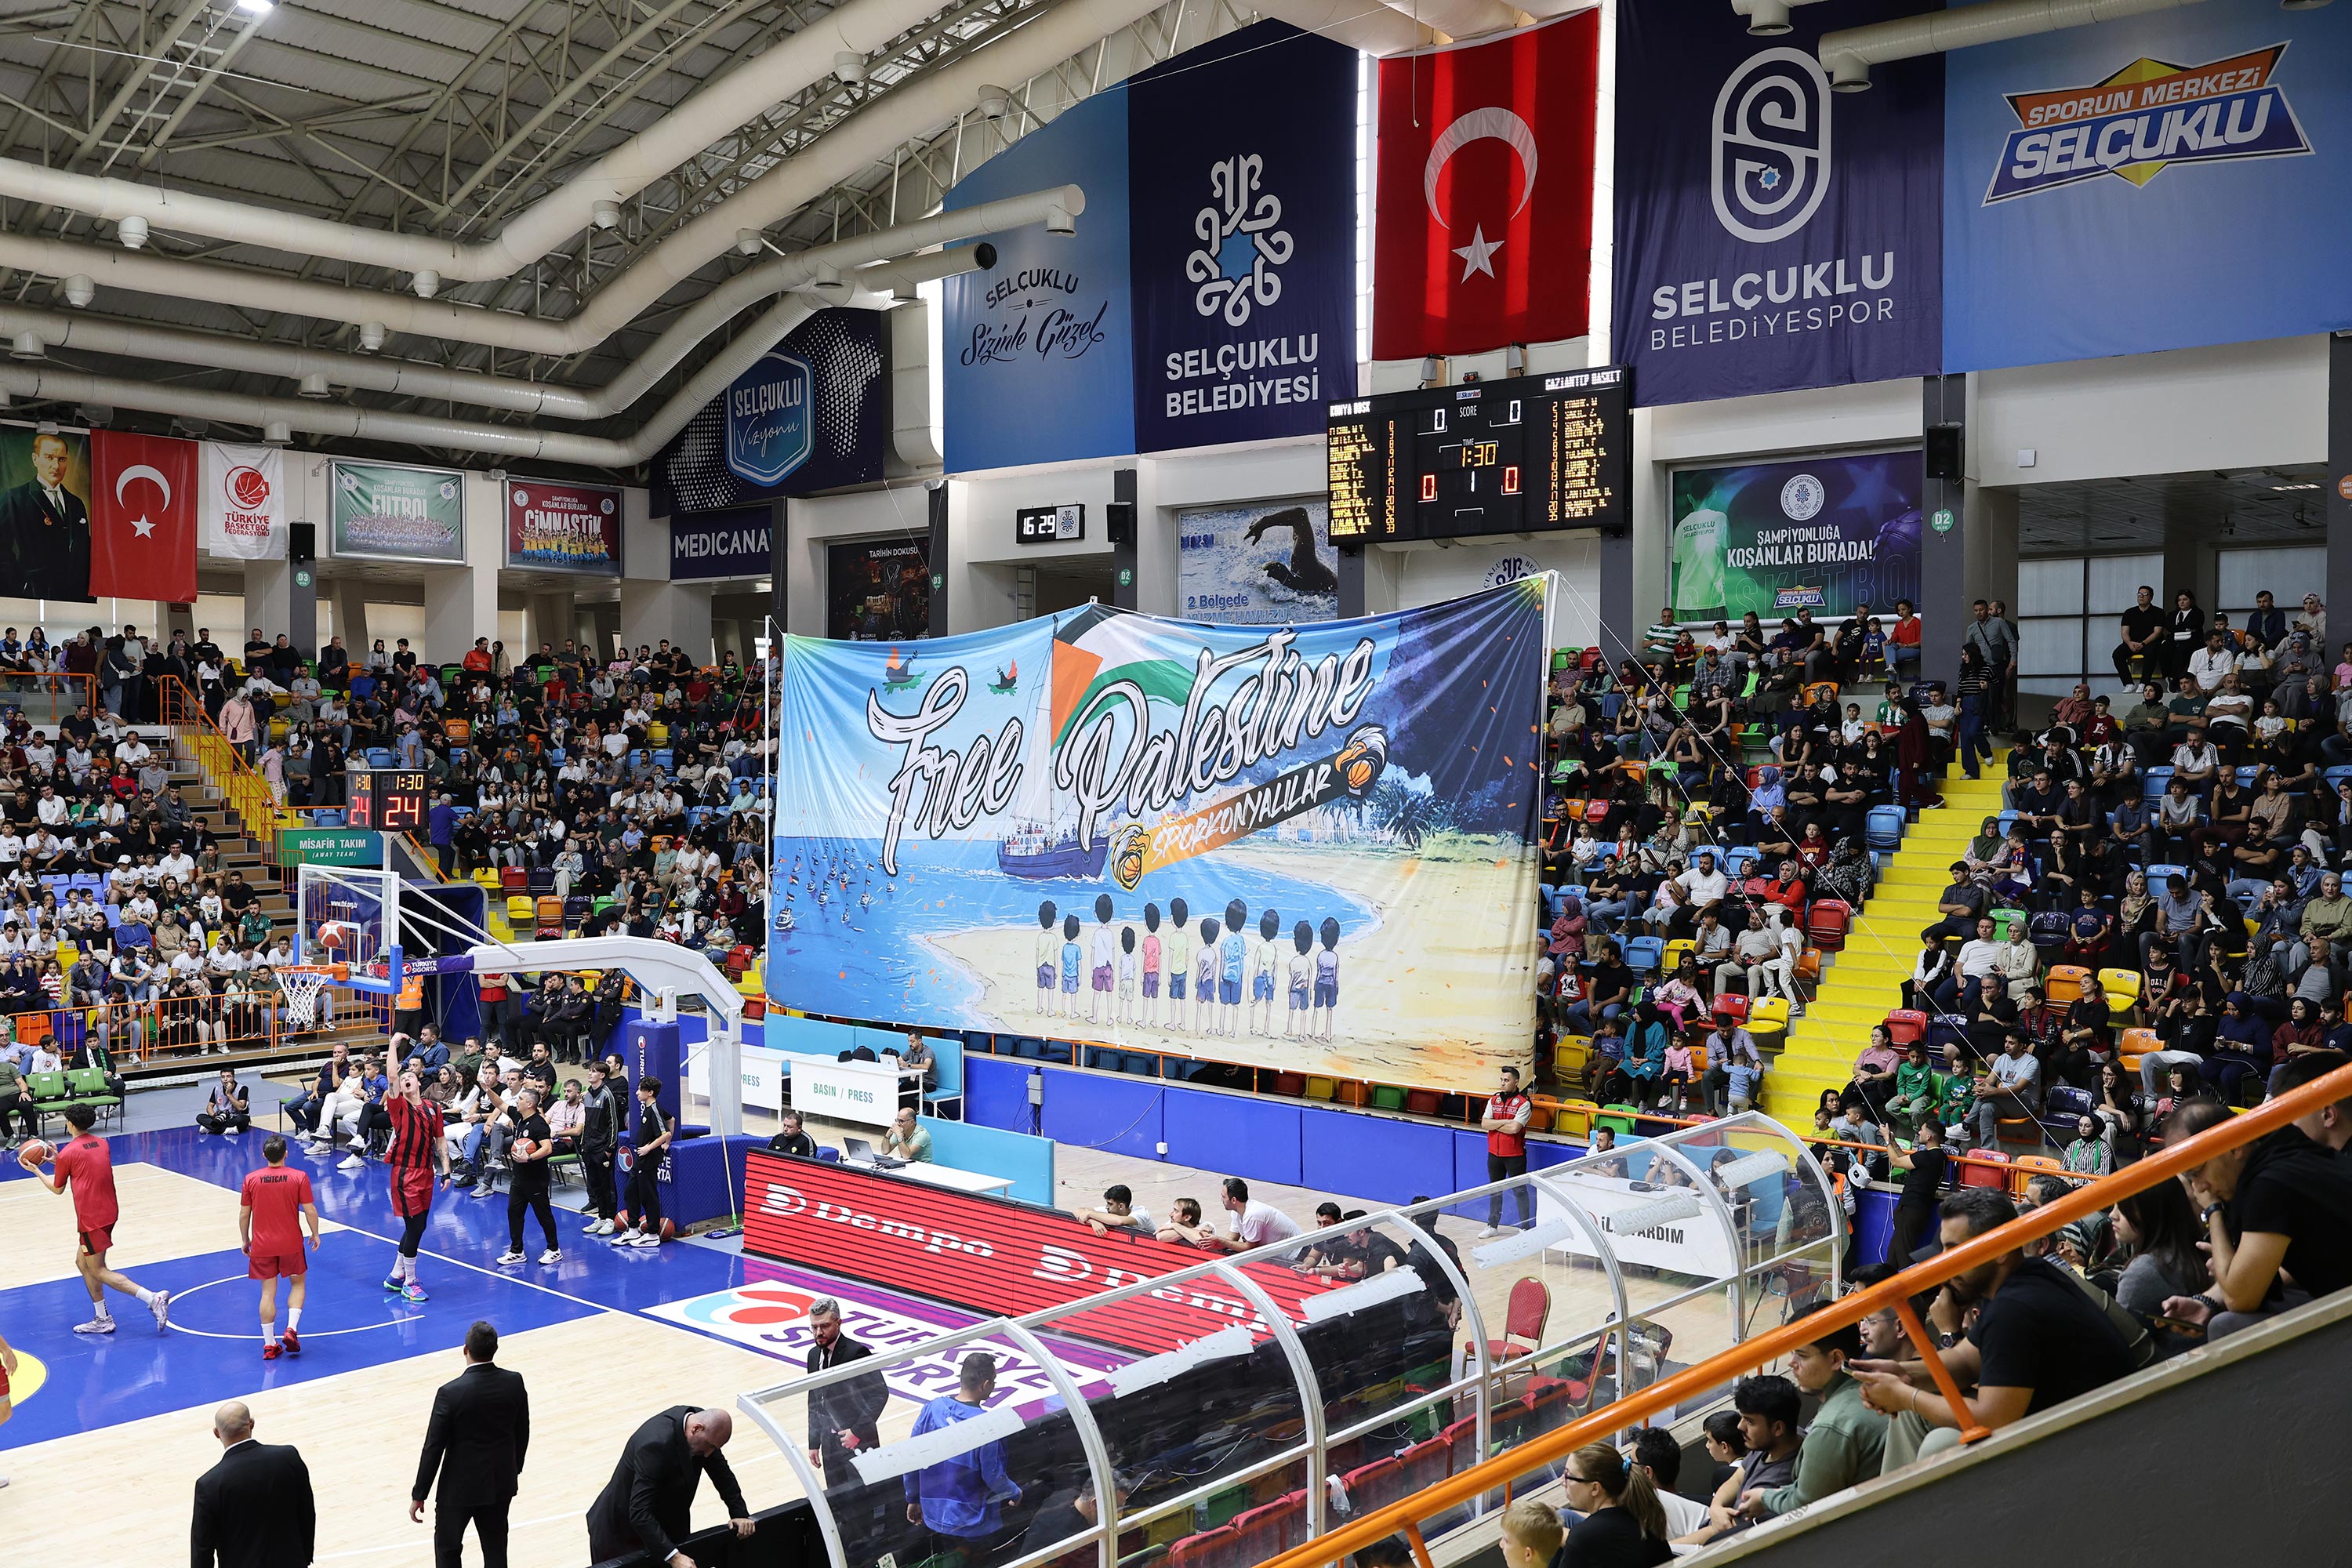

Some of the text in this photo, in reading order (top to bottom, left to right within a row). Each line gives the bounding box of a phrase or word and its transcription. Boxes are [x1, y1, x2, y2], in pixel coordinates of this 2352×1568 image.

[2027, 89, 2134, 126] SPORUN
[2011, 93, 2273, 180] SELÇUKLU
[986, 268, 1079, 309] SELÇUKLU
[1651, 251, 1893, 320] SELÇUKLU
[960, 300, 1108, 366] Sizinle Güzel
[1166, 332, 1319, 381] SELÇUKLU
[735, 377, 802, 418] SELÇUKLU
[1166, 367, 1319, 418] BELEDİYESİ
[1434, 408, 1446, 430] 0
[1459, 405, 1477, 418] SCORE
[1508, 400, 1521, 423] 0
[737, 416, 800, 458] Vizyonu
[1461, 443, 1497, 468] 1:30
[1423, 474, 1435, 499] 0
[1504, 466, 1518, 492] 0
[225, 510, 270, 524] TÜRKİYE
[225, 521, 270, 532] BASKETBOL
[1934, 514, 1951, 524] D2
[225, 528, 270, 537] FEDERASYONU
[675, 528, 770, 558] MEDICANA
[1757, 524, 1841, 546] ŞAMPİYONLUĞA
[869, 546, 918, 558] TARİHİN DOKUSU
[1727, 539, 1873, 568] KOŞANLAR BURADA!
[298, 572, 309, 582] D3
[1120, 572, 1130, 580] D2
[1188, 592, 1249, 611] 2 Bölgede
[1235, 608, 1289, 625] HAVUZU
[866, 627, 1376, 877] Free Palestine
[355, 775, 372, 790] 1:30
[396, 774, 424, 790] 1:30
[350, 796, 371, 826] 24
[386, 796, 420, 826] 24
[1151, 764, 1331, 863] SPORKONYALILAR
[299, 838, 366, 849] MİSAFİR TAKIM
[2151, 978, 2167, 988] ULLS
[813, 1083, 837, 1097] BASIN
[848, 1088, 873, 1104] PRESS
[812, 1201, 994, 1258] Dempo
